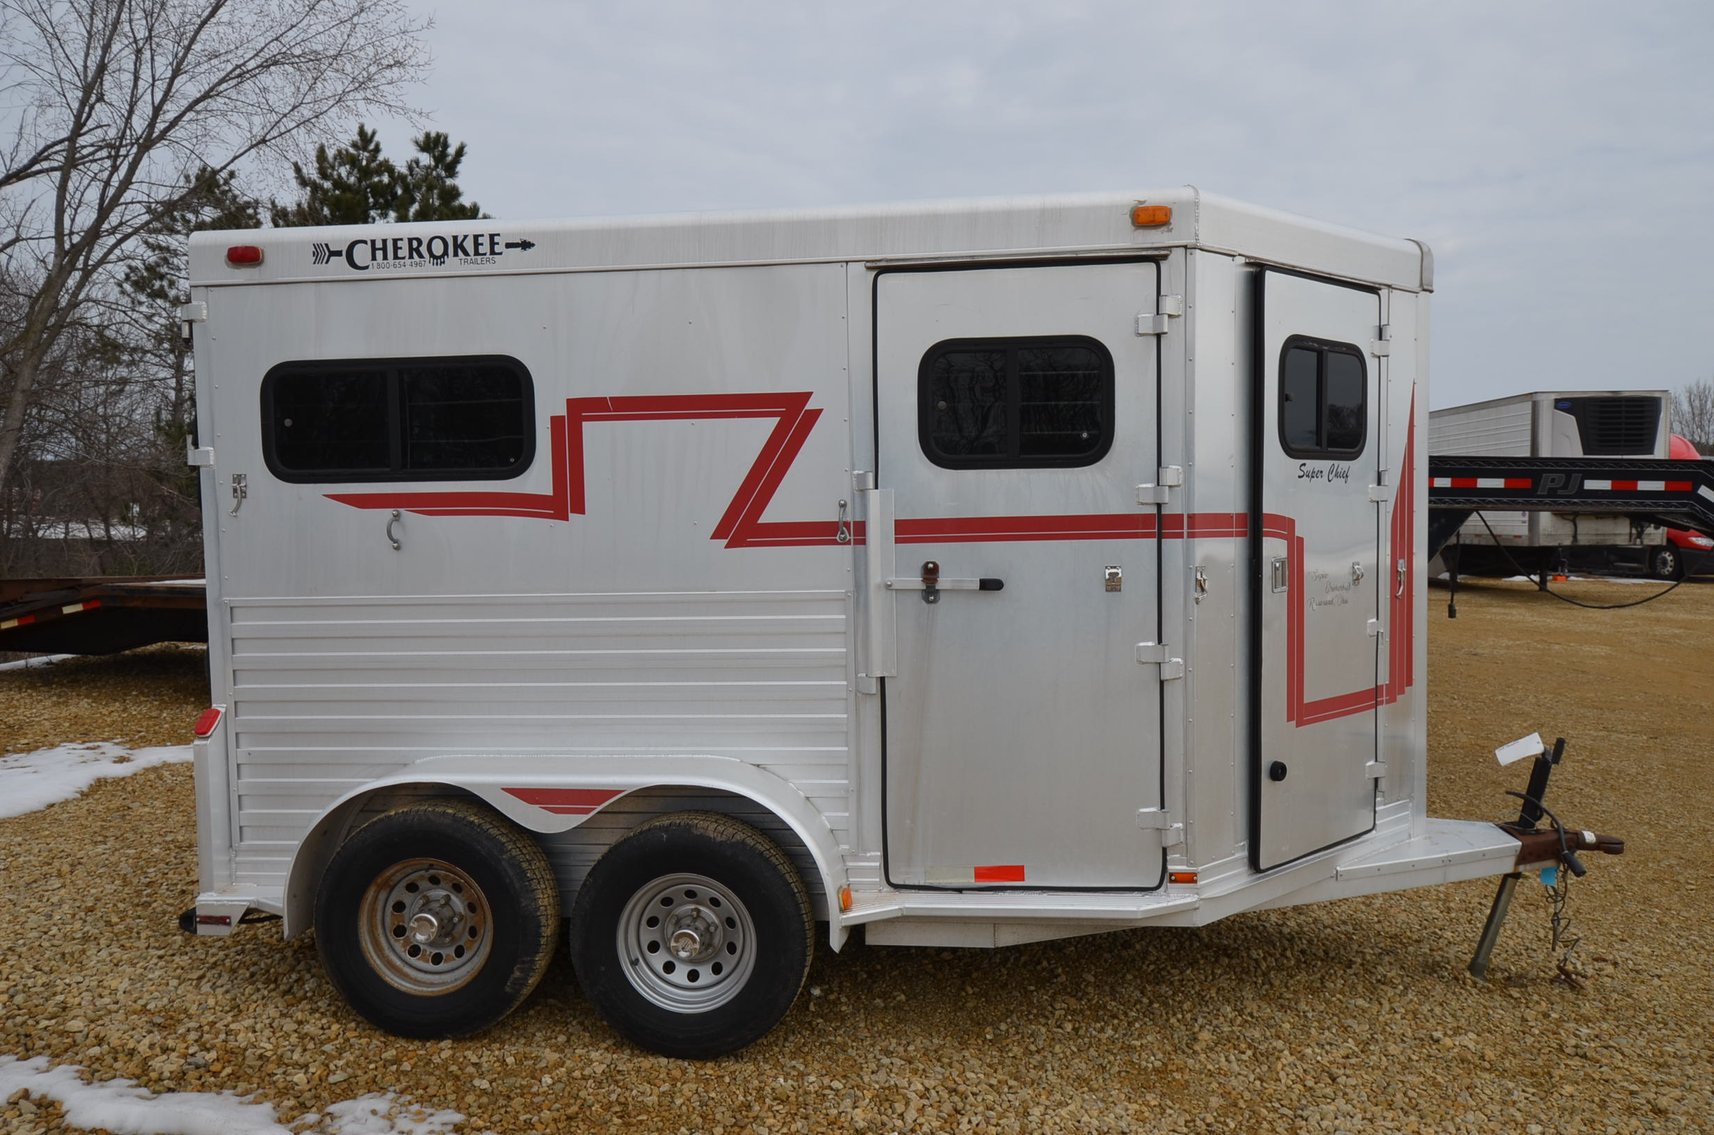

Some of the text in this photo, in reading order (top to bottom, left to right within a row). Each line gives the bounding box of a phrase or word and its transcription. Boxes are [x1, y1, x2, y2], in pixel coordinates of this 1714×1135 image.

[345, 233, 503, 270] CHEROKEE
[458, 256, 497, 266] TRAILERS
[1297, 463, 1351, 483] Super Chief
[1537, 473, 1583, 495] PJ
